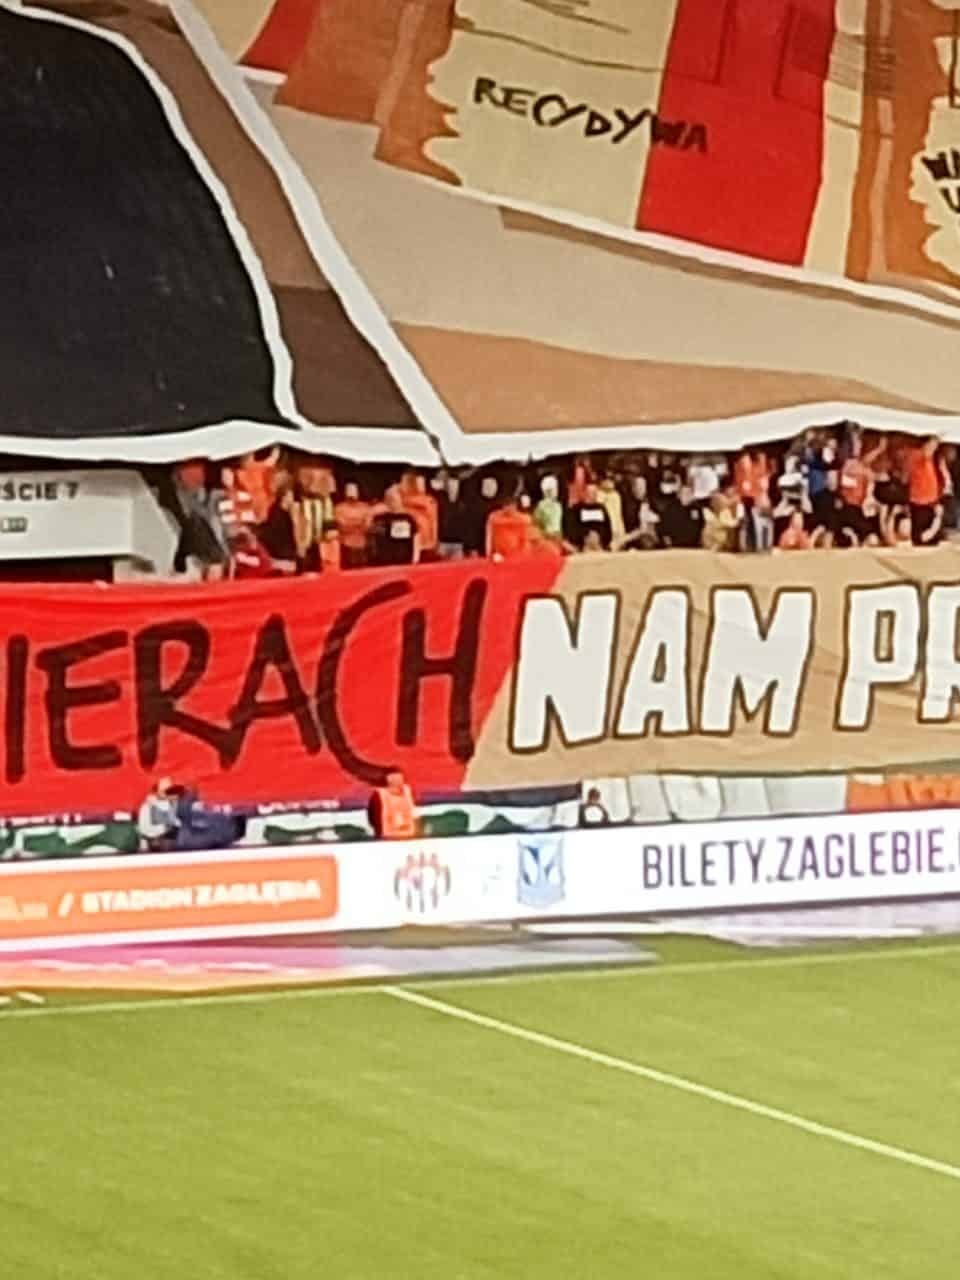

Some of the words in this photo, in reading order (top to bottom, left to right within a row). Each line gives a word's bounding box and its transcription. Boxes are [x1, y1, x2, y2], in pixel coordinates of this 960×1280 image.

[473, 77, 708, 153] RECYDYWA
[65, 481, 79, 499] 7
[506, 584, 816, 755] NAM
